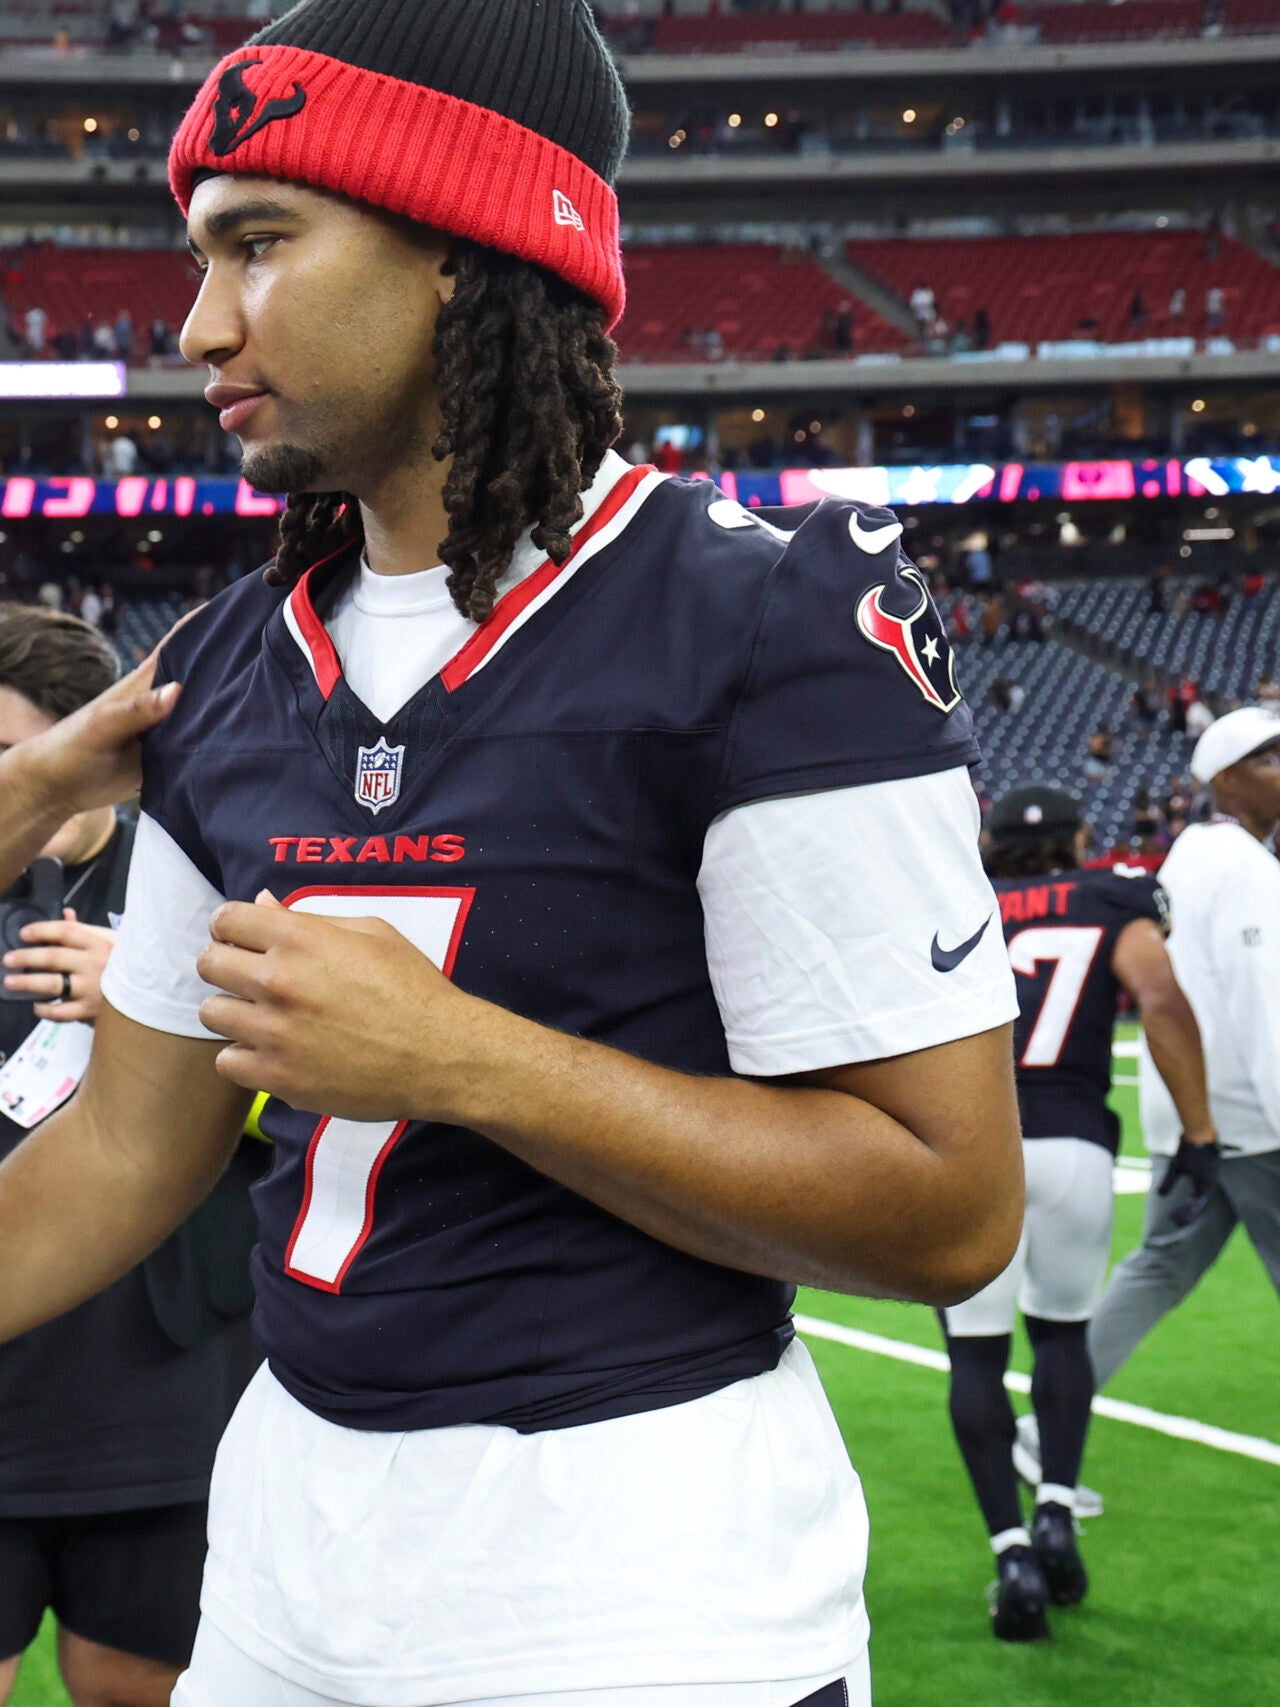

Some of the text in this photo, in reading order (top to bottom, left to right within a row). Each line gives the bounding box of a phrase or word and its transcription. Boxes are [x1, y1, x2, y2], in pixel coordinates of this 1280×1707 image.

[362, 772, 392, 800] NFL
[268, 833, 466, 863] TEXANS
[282, 884, 477, 1296] 7
